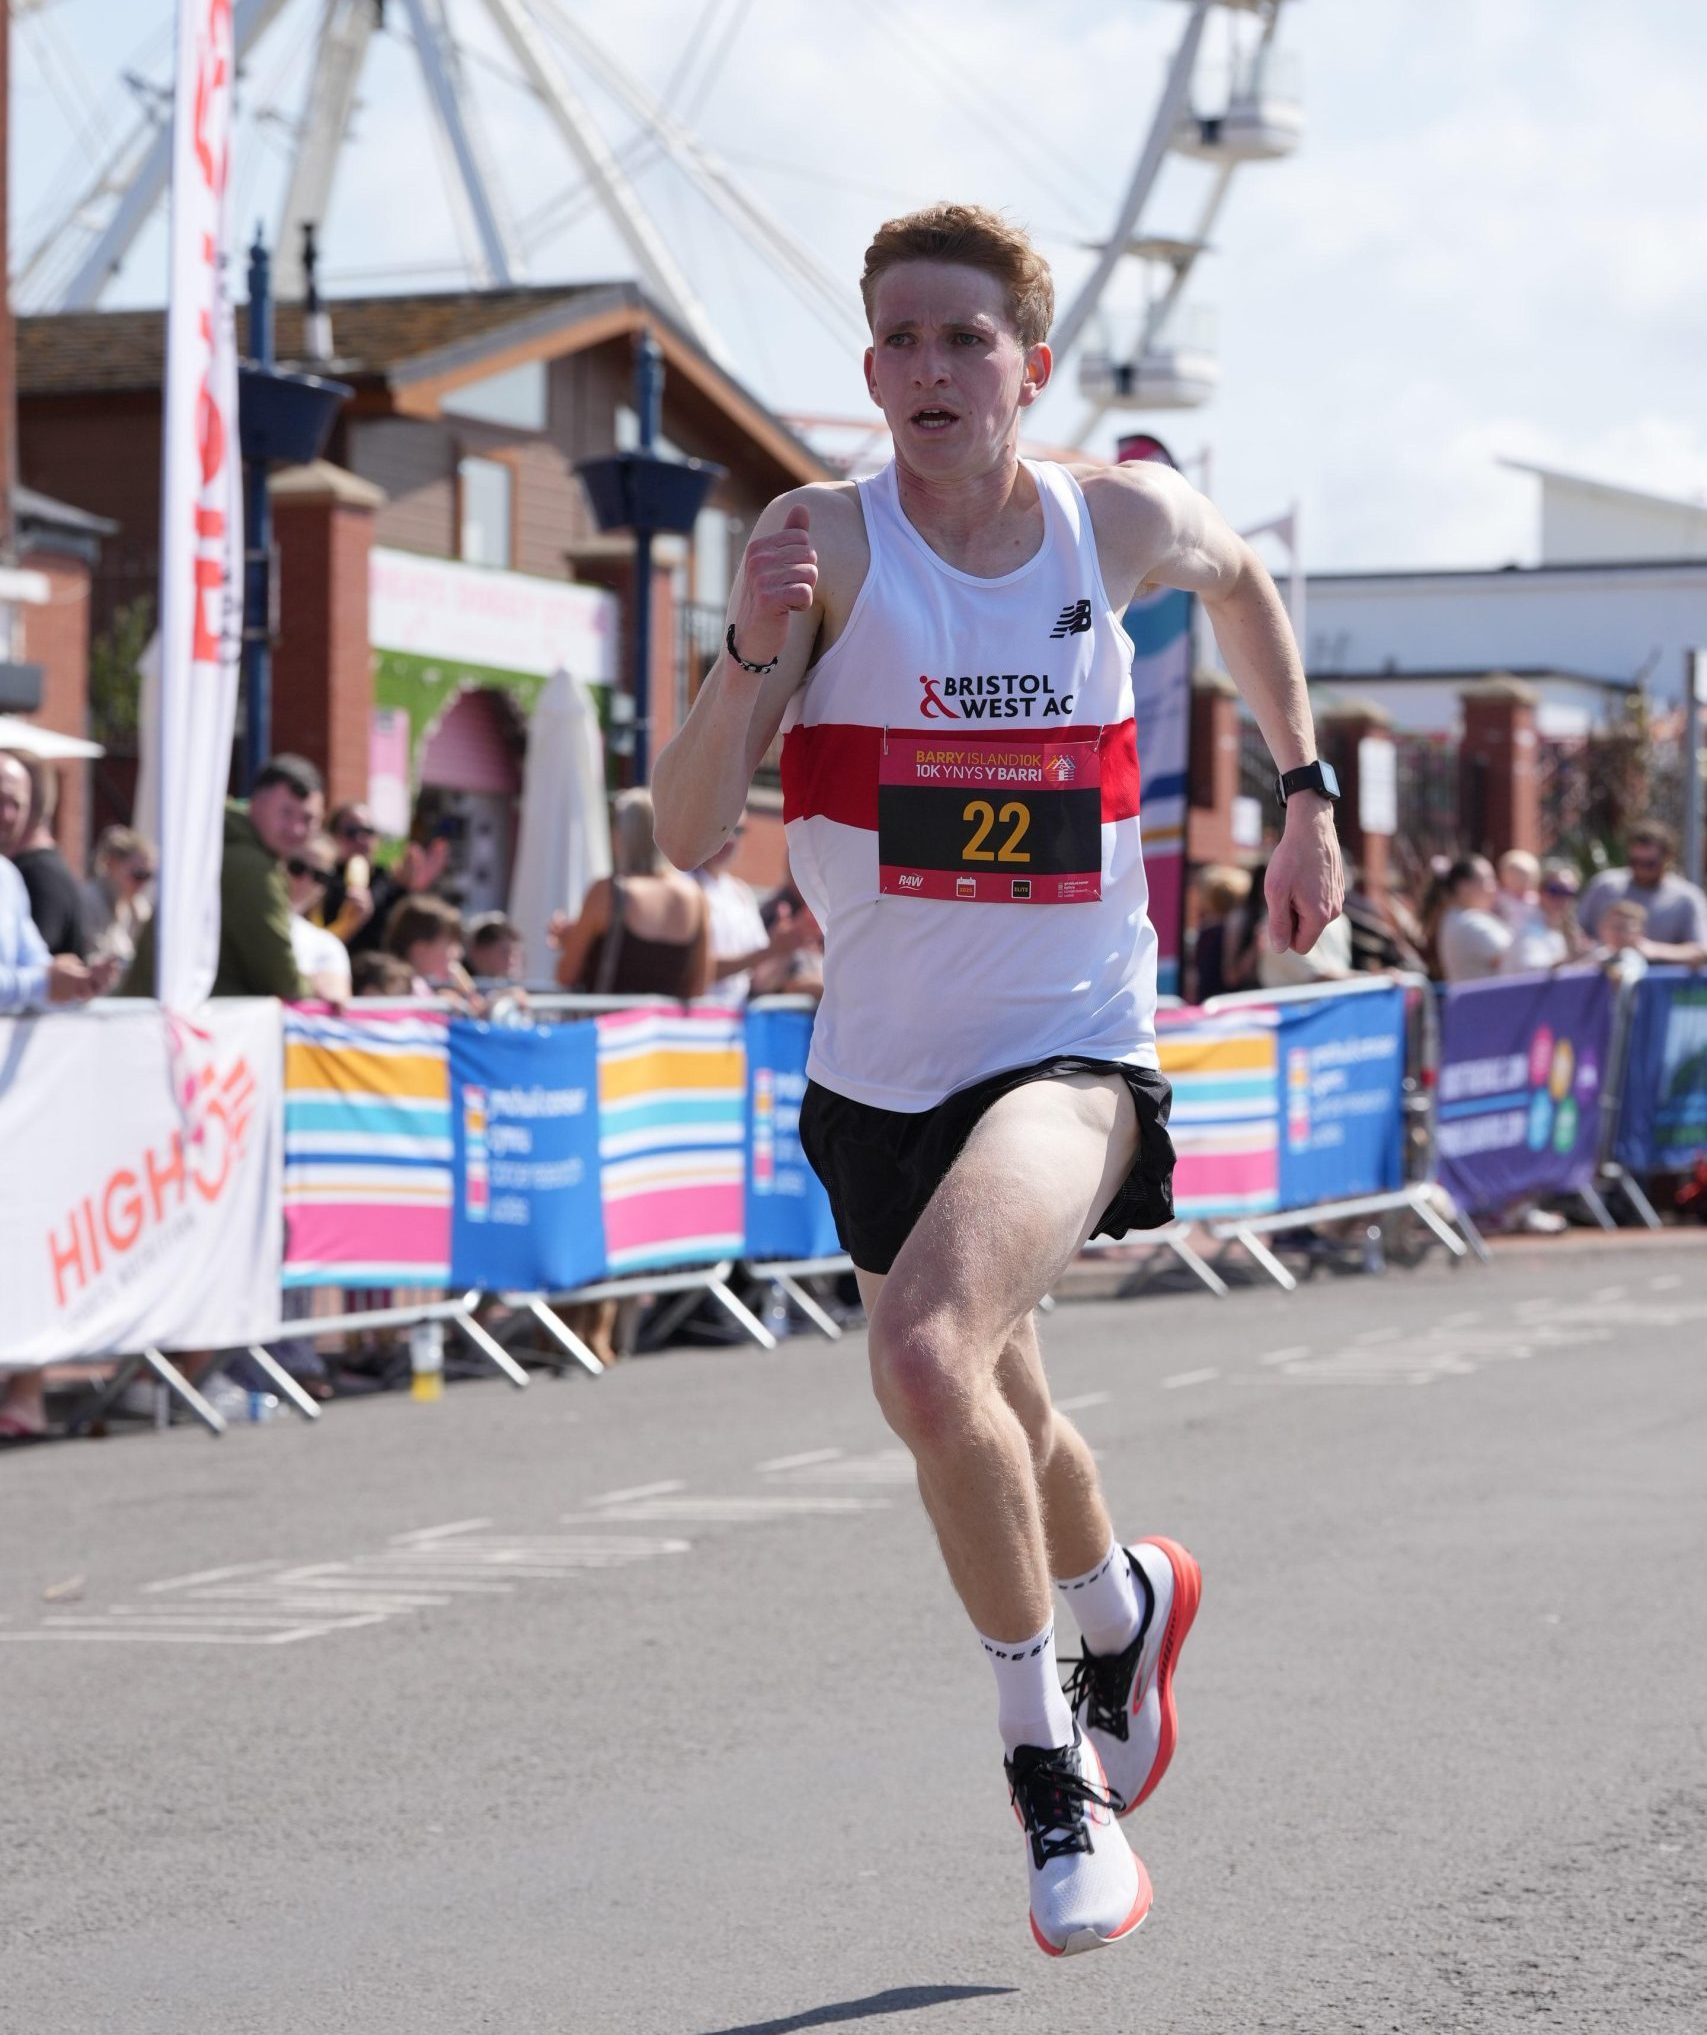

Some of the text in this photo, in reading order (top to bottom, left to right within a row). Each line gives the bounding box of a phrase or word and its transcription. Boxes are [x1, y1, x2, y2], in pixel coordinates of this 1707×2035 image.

[944, 674, 1055, 697] BRISTOL
[959, 697, 1037, 719] WEST
[1042, 694, 1074, 717] AC
[916, 750, 966, 765] BARRY
[916, 764, 1042, 782] 10K YNYS Y BARRI
[962, 800, 1030, 862] 22
[898, 874, 924, 887] R4W
